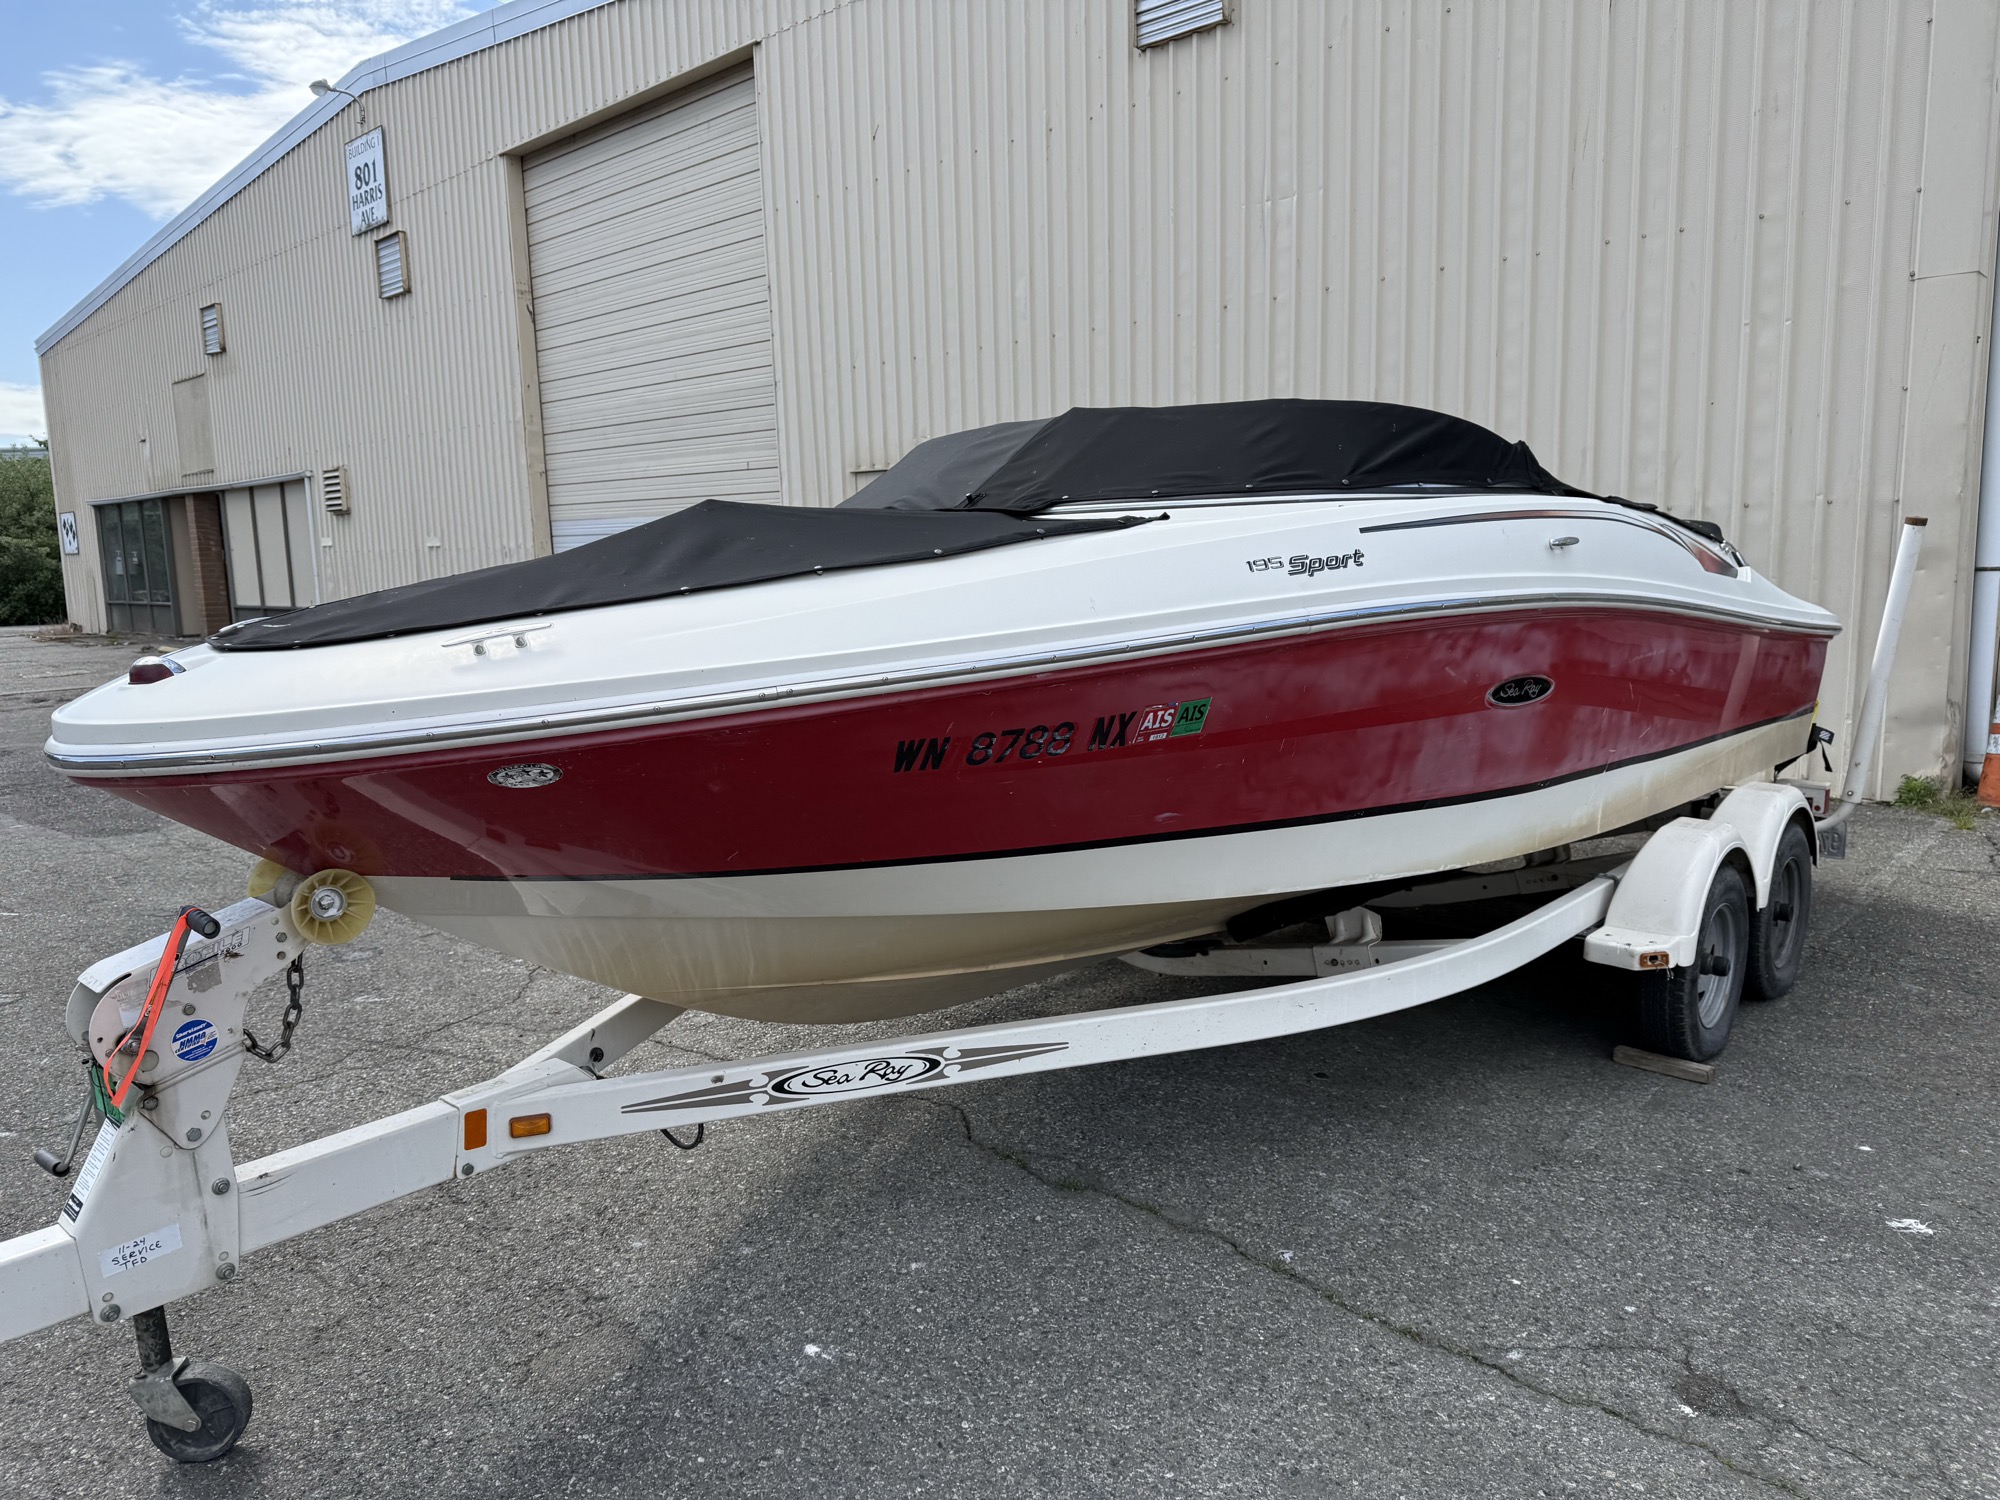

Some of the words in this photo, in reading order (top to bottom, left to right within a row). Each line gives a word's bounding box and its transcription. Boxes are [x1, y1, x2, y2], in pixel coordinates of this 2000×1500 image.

[348, 136, 376, 160] BUILDING
[354, 158, 378, 191] 801
[352, 183, 383, 211] HARRIS
[360, 206, 379, 226] AVE.
[1246, 556, 1284, 572] 195
[1288, 549, 1364, 577] Sport
[1500, 683, 1520, 698] Sea
[1521, 679, 1542, 698] Ray
[1140, 709, 1175, 731] AIS
[1177, 703, 1207, 724] AIS
[893, 737, 951, 773] WN
[965, 721, 1075, 766] 8788
[1087, 711, 1138, 751] NX
[801, 1069, 856, 1088] Sea
[859, 1060, 913, 1081] Ray
[111, 1240, 162, 1266] SERVICE
[118, 1237, 146, 1254] 11-24
[119, 1256, 148, 1270] TFD
